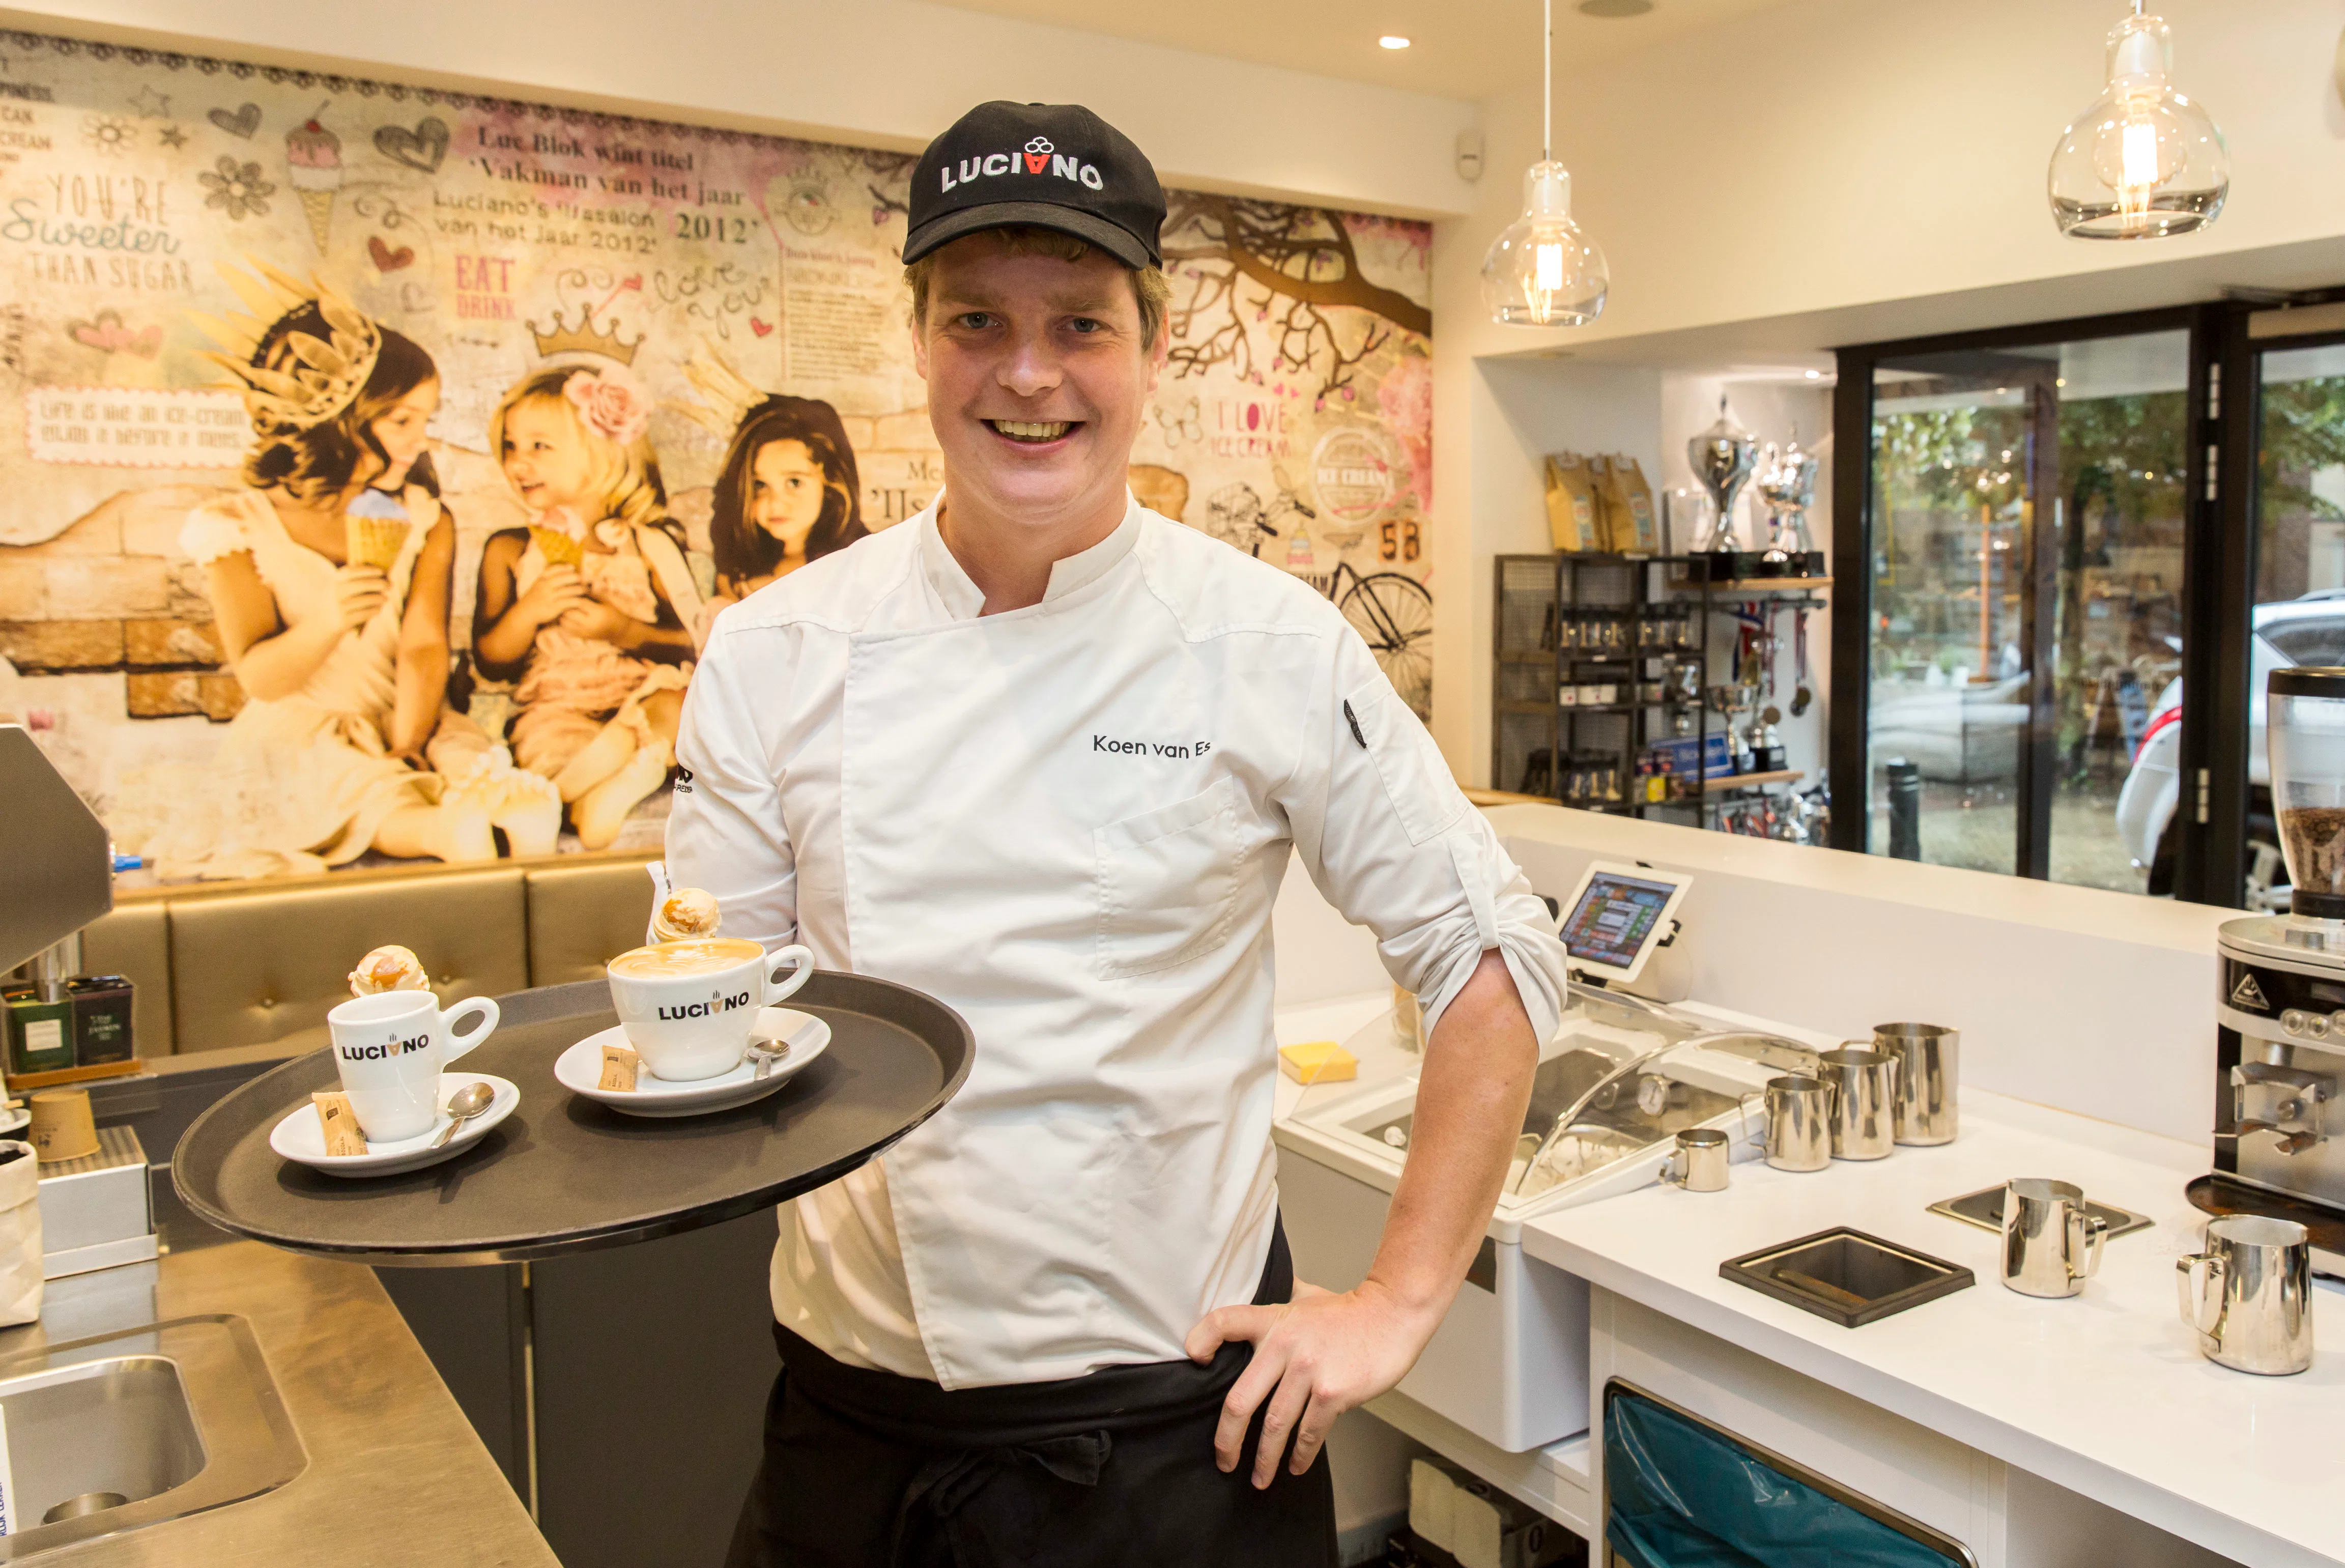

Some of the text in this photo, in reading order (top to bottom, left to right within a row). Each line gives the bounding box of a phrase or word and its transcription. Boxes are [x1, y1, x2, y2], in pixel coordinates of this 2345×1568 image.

[478, 126, 693, 170] Luc Blok wint titel
[941, 152, 1103, 193] LUCIANO
[597, 175, 642, 194] van
[651, 176, 687, 200] het
[698, 181, 741, 206] jaar
[2, 197, 181, 254] Sweeter
[434, 218, 478, 237] van
[27, 251, 194, 294] THAN SUGAR
[456, 254, 516, 293] EAT
[456, 293, 517, 320] DRINK
[1236, 402, 1288, 434] LOVE
[1211, 437, 1292, 459] ICE CREAM
[1317, 468, 1337, 484] ICE
[1094, 735, 1147, 755] Koen
[1153, 744, 1189, 759] van
[659, 992, 749, 1020] LUCIANO
[341, 1034, 430, 1061] LUCIANO
